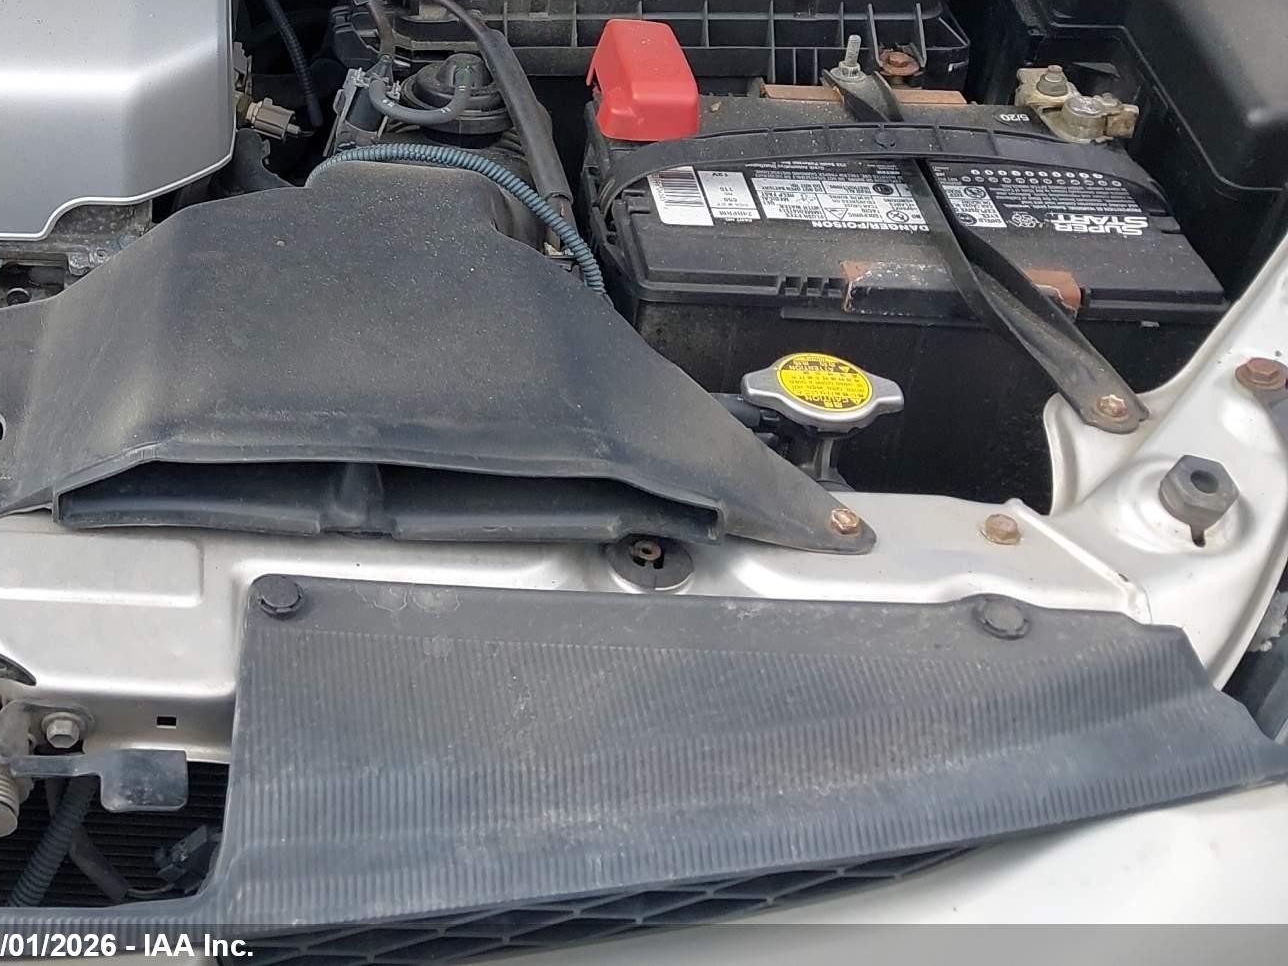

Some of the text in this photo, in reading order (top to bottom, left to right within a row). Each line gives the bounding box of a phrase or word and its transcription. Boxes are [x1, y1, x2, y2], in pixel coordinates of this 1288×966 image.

[1000, 114, 1030, 122] 5/20
[812, 220, 930, 232] DANGER/POISON
[1050, 215, 1148, 228] START
[1054, 223, 1143, 236] SUPER
[804, 395, 849, 403] CAUTION
